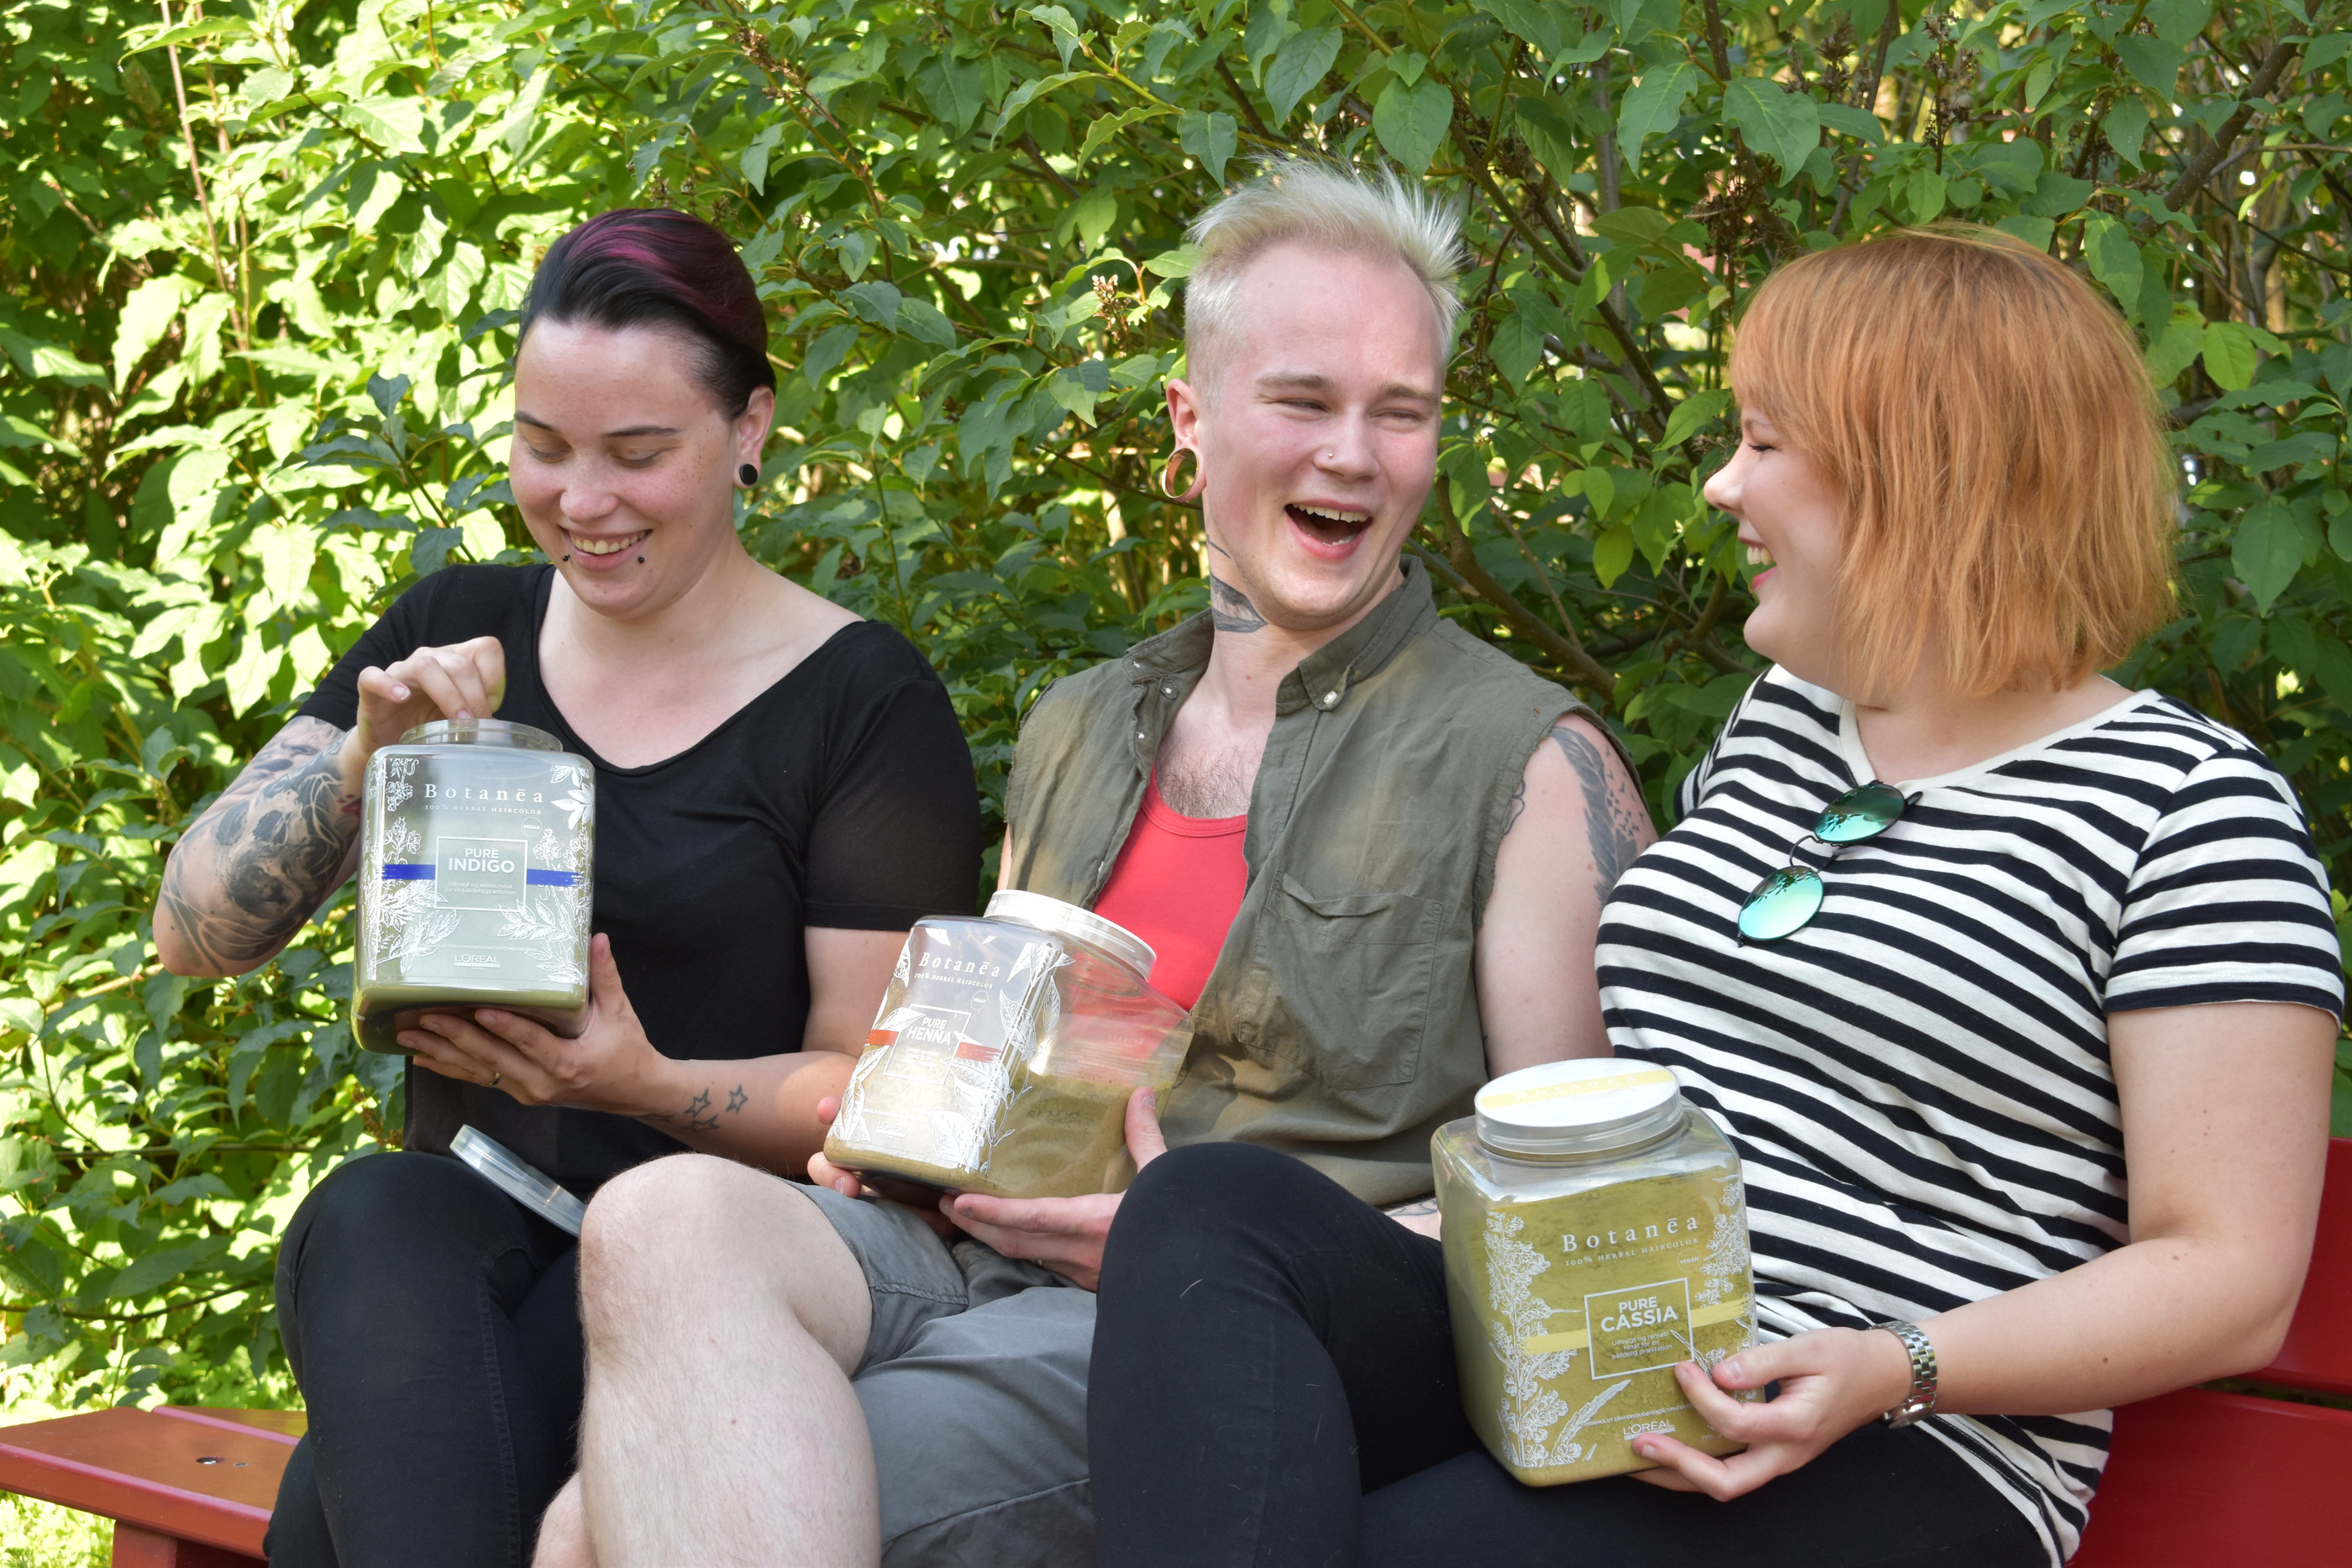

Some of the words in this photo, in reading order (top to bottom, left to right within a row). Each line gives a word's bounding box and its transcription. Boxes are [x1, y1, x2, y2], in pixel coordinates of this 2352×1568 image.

[424, 784, 543, 803] Botanēa
[465, 847, 500, 858] PURE
[448, 857, 515, 873] INDIGO
[919, 952, 1000, 978] Botanēa
[932, 974, 954, 983] HERBAL
[957, 978, 993, 989] HAIRCOLOR
[921, 1016, 948, 1030] PURE
[906, 1025, 952, 1046] HENNA
[1562, 1217, 1698, 1252] Botanēa
[1566, 1256, 1593, 1266] 100%
[1598, 1249, 1636, 1261] HERBAL
[1641, 1237, 1698, 1254] HAIRCOLOR
[1679, 1256, 1699, 1265] VEGAN
[1618, 1296, 1658, 1314] PURE
[1600, 1305, 1678, 1332] CASSIA
